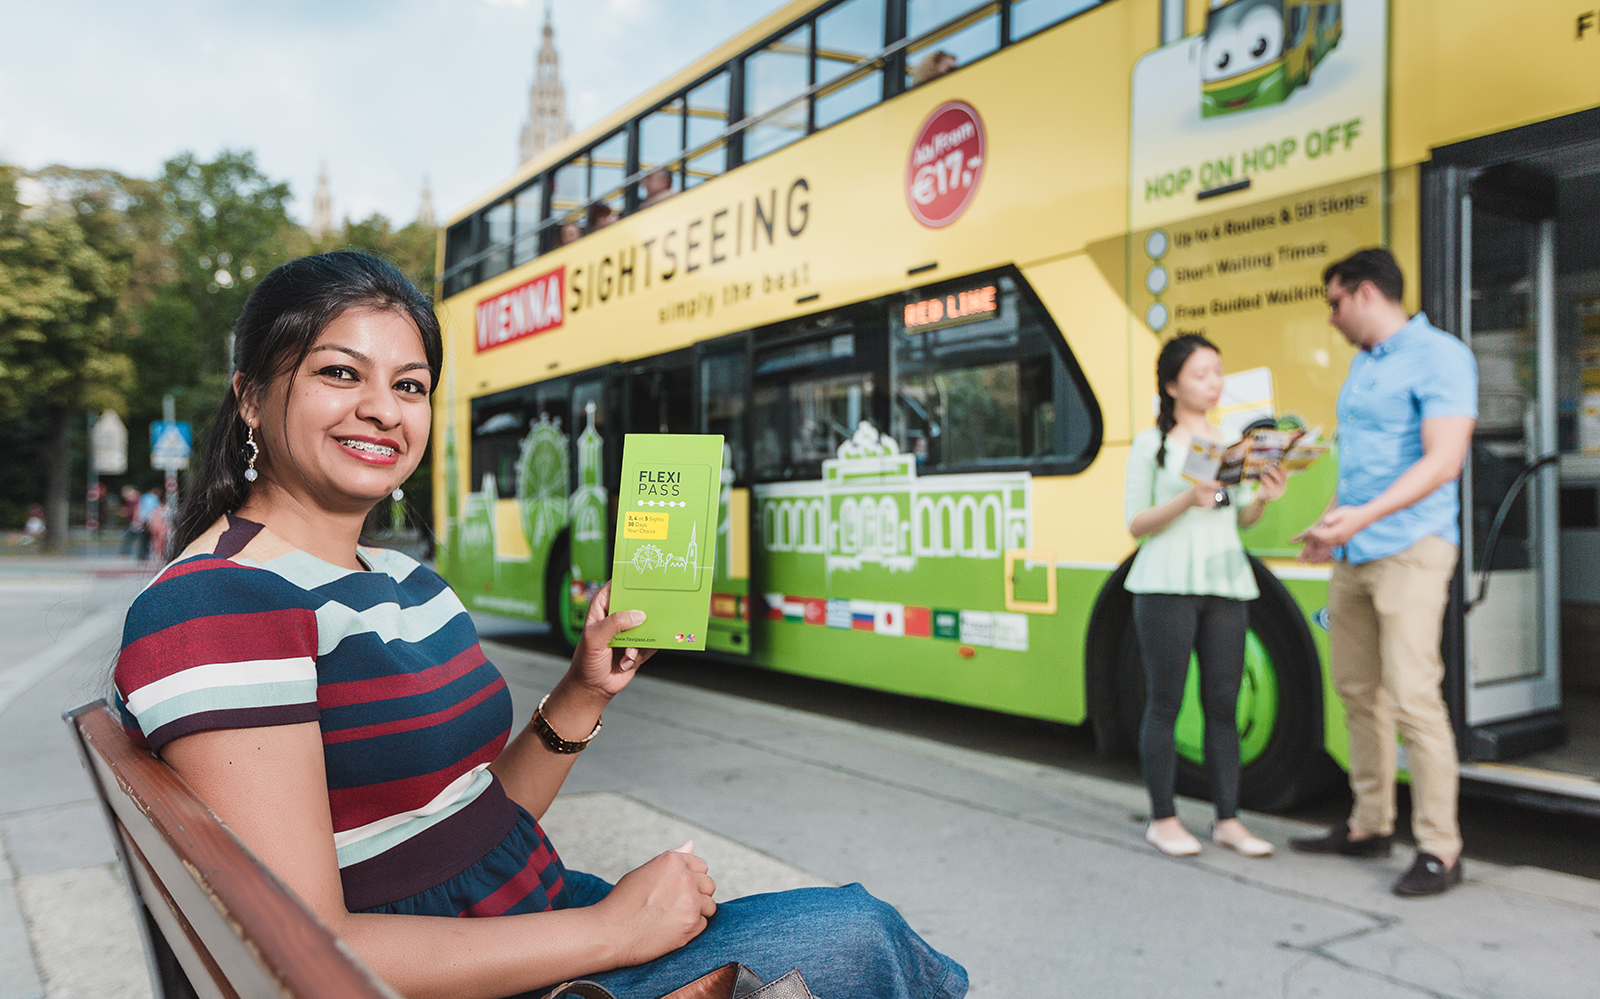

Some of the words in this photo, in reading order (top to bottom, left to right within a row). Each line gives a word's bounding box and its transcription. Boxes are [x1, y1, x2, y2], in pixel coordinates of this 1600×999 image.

[1146, 169, 1191, 199] HOP
[1200, 157, 1233, 187] ON
[1243, 139, 1296, 174] HOP
[1305, 118, 1361, 158] OFF
[1174, 232, 1192, 247] Up
[1195, 226, 1208, 240] to
[1223, 212, 1277, 234] Routes
[1279, 207, 1292, 223] &
[1319, 193, 1368, 214] Stops
[476, 274, 562, 350] VIENNA
[569, 178, 810, 313] SIGHTSEEING
[1175, 263, 1214, 283] Short
[1216, 253, 1274, 276] Waiting
[1278, 243, 1327, 262] Times
[658, 290, 717, 326] simply
[722, 280, 752, 301] the
[762, 263, 810, 294] best
[946, 286, 997, 318] LINE
[1174, 303, 1206, 320] Free
[1210, 292, 1262, 315] Guided
[1265, 285, 1329, 305] Walking
[638, 483, 680, 496] PASS
[639, 470, 680, 483] FLEXI
